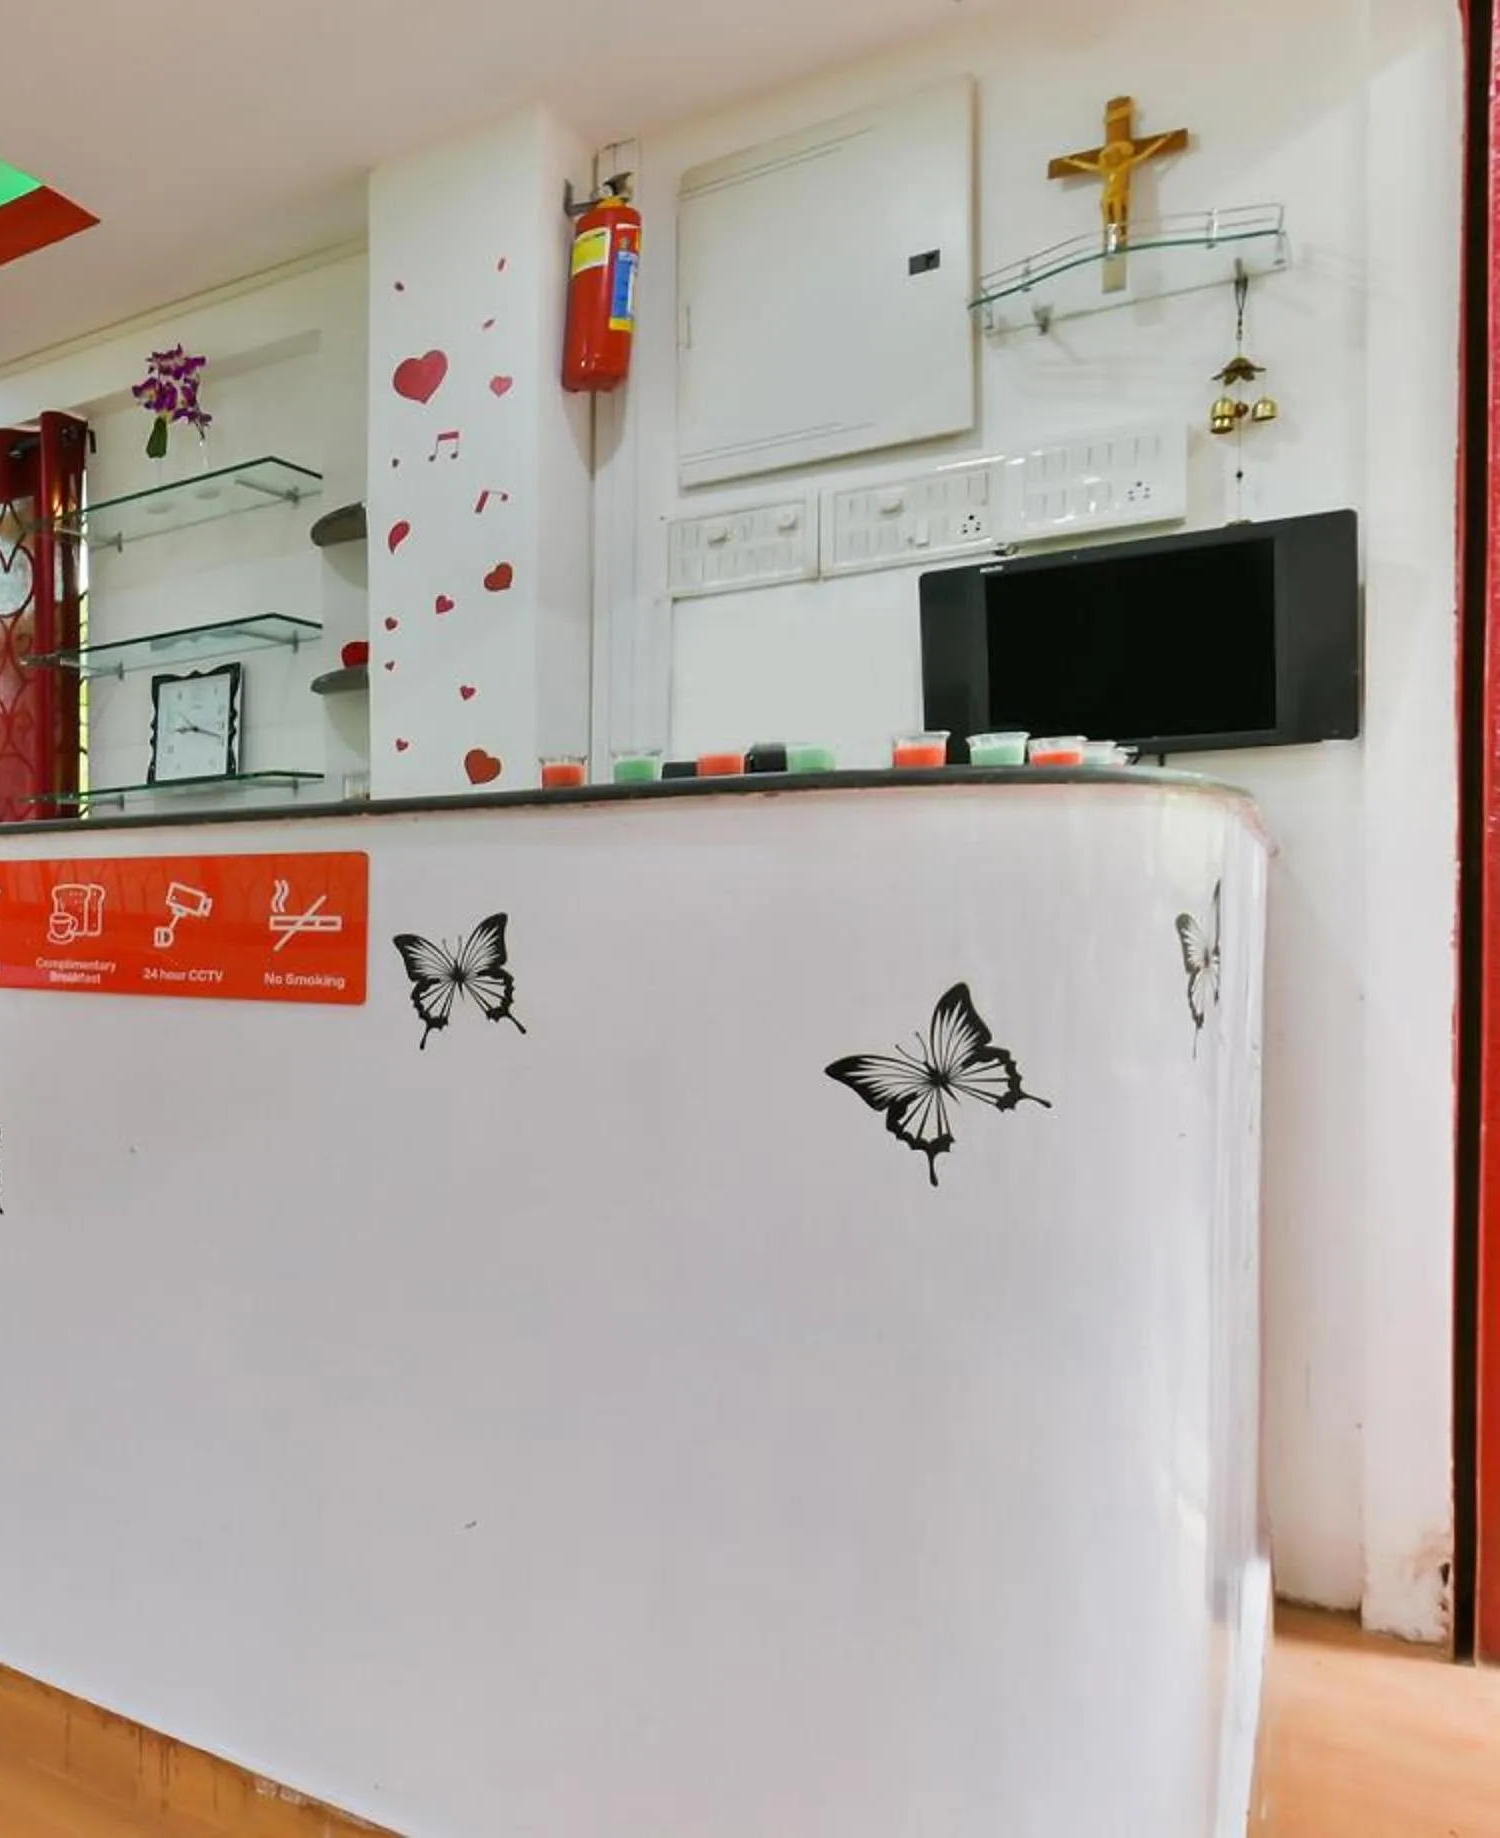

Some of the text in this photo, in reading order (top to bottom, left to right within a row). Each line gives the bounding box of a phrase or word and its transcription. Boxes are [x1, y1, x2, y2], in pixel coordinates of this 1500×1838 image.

[36, 957, 117, 974] Complimentary
[143, 968, 223, 982] 24 hour CCTV
[264, 972, 345, 989] No Smoking
